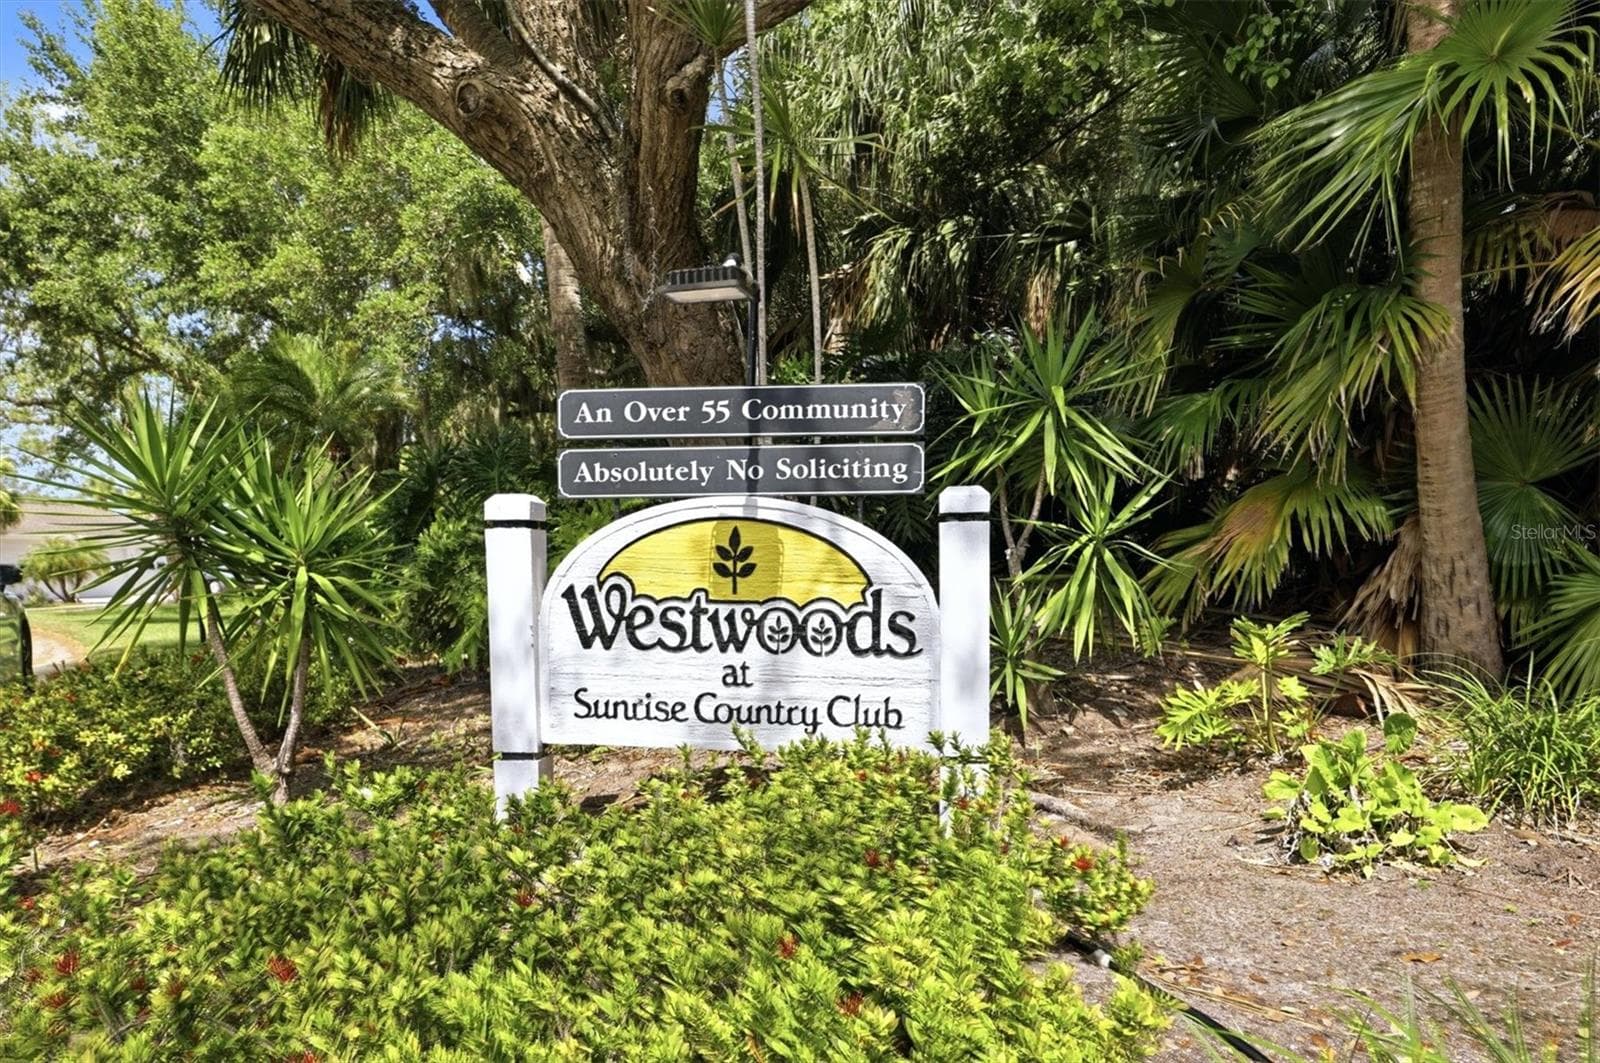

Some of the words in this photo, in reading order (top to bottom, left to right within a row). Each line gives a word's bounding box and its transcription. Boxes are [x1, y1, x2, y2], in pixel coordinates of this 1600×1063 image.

[574, 402, 613, 423] An
[624, 400, 691, 423] Over
[701, 399, 731, 424] 55
[742, 398, 907, 423] Community
[573, 460, 714, 486] Absolutely
[726, 459, 764, 481] No
[776, 457, 908, 484] Soliciting
[560, 583, 923, 659] Westwoods
[722, 661, 753, 688] at
[574, 688, 689, 722] Sunrise
[694, 692, 822, 734] Country
[827, 694, 905, 730] Club
